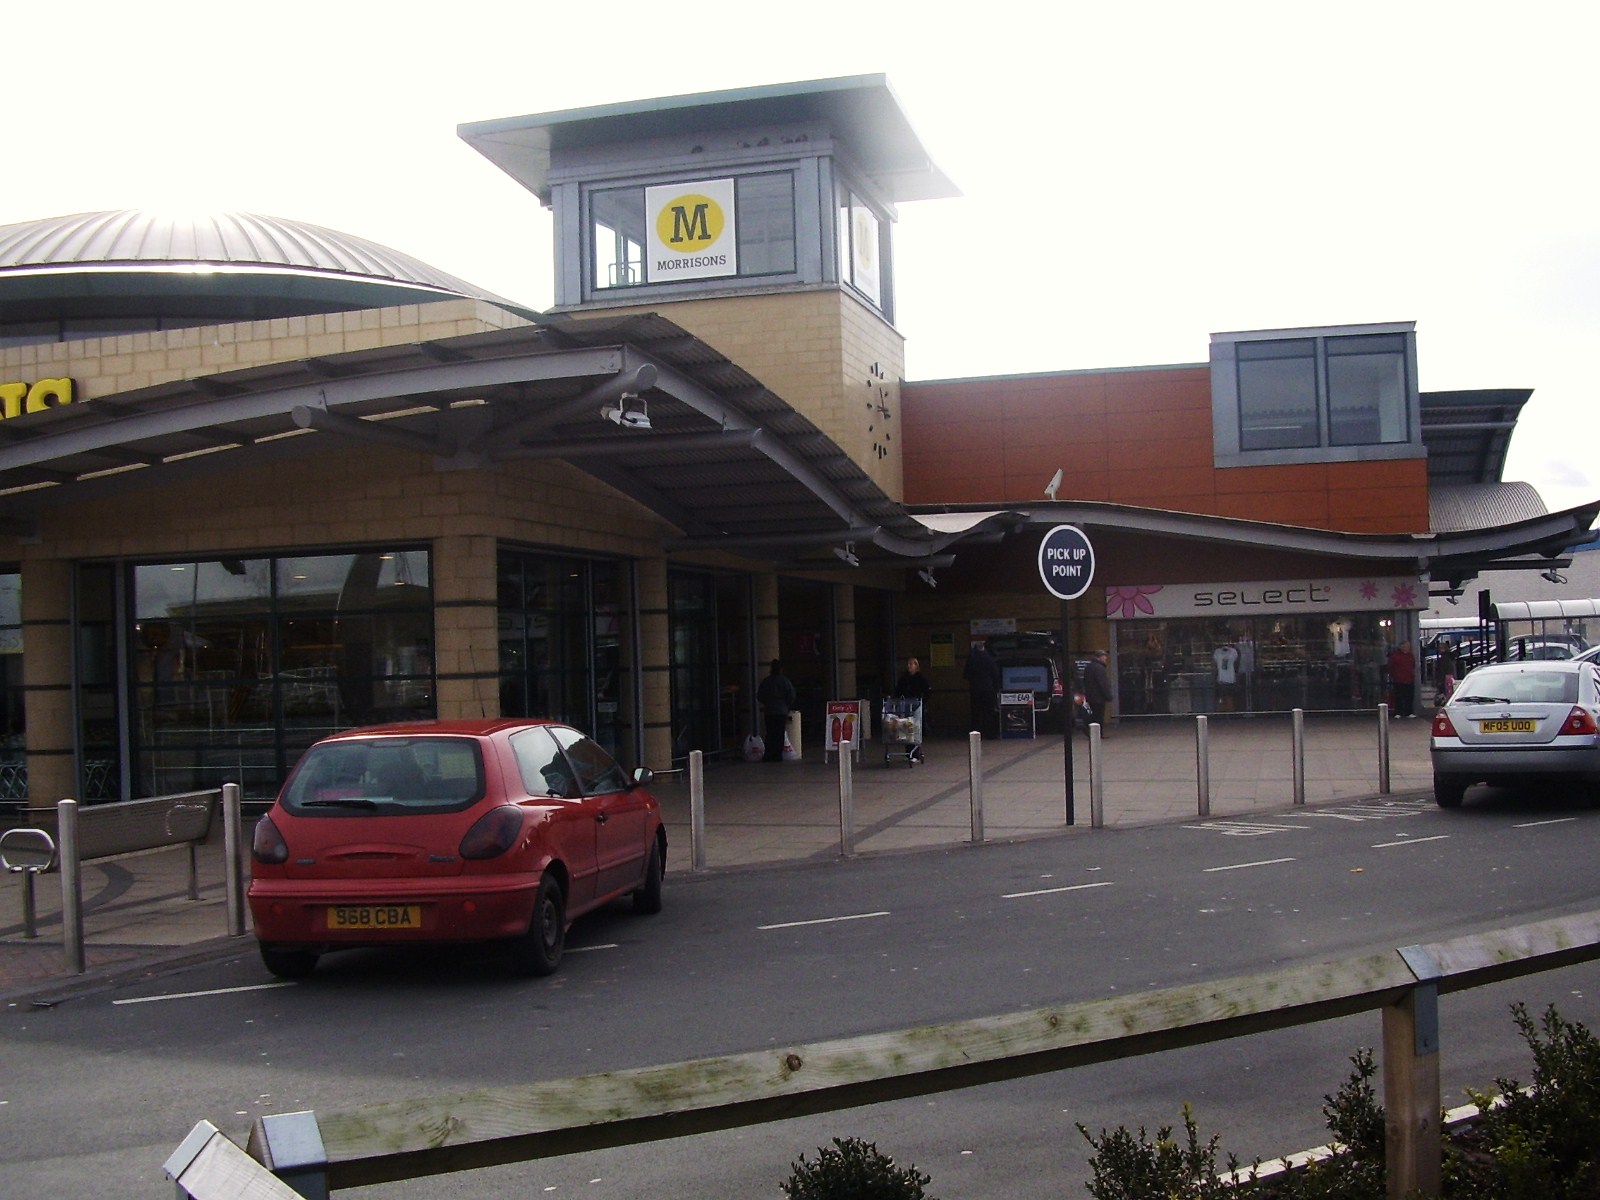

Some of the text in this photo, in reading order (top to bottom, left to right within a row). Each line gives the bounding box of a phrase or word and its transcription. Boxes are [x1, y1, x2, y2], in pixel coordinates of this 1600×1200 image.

[670, 203, 711, 243] M
[657, 254, 727, 271] MORRISONS
[1047, 548, 1086, 560] PICK UP
[1052, 565, 1082, 577] POINT
[375, 908, 411, 926] CBA
